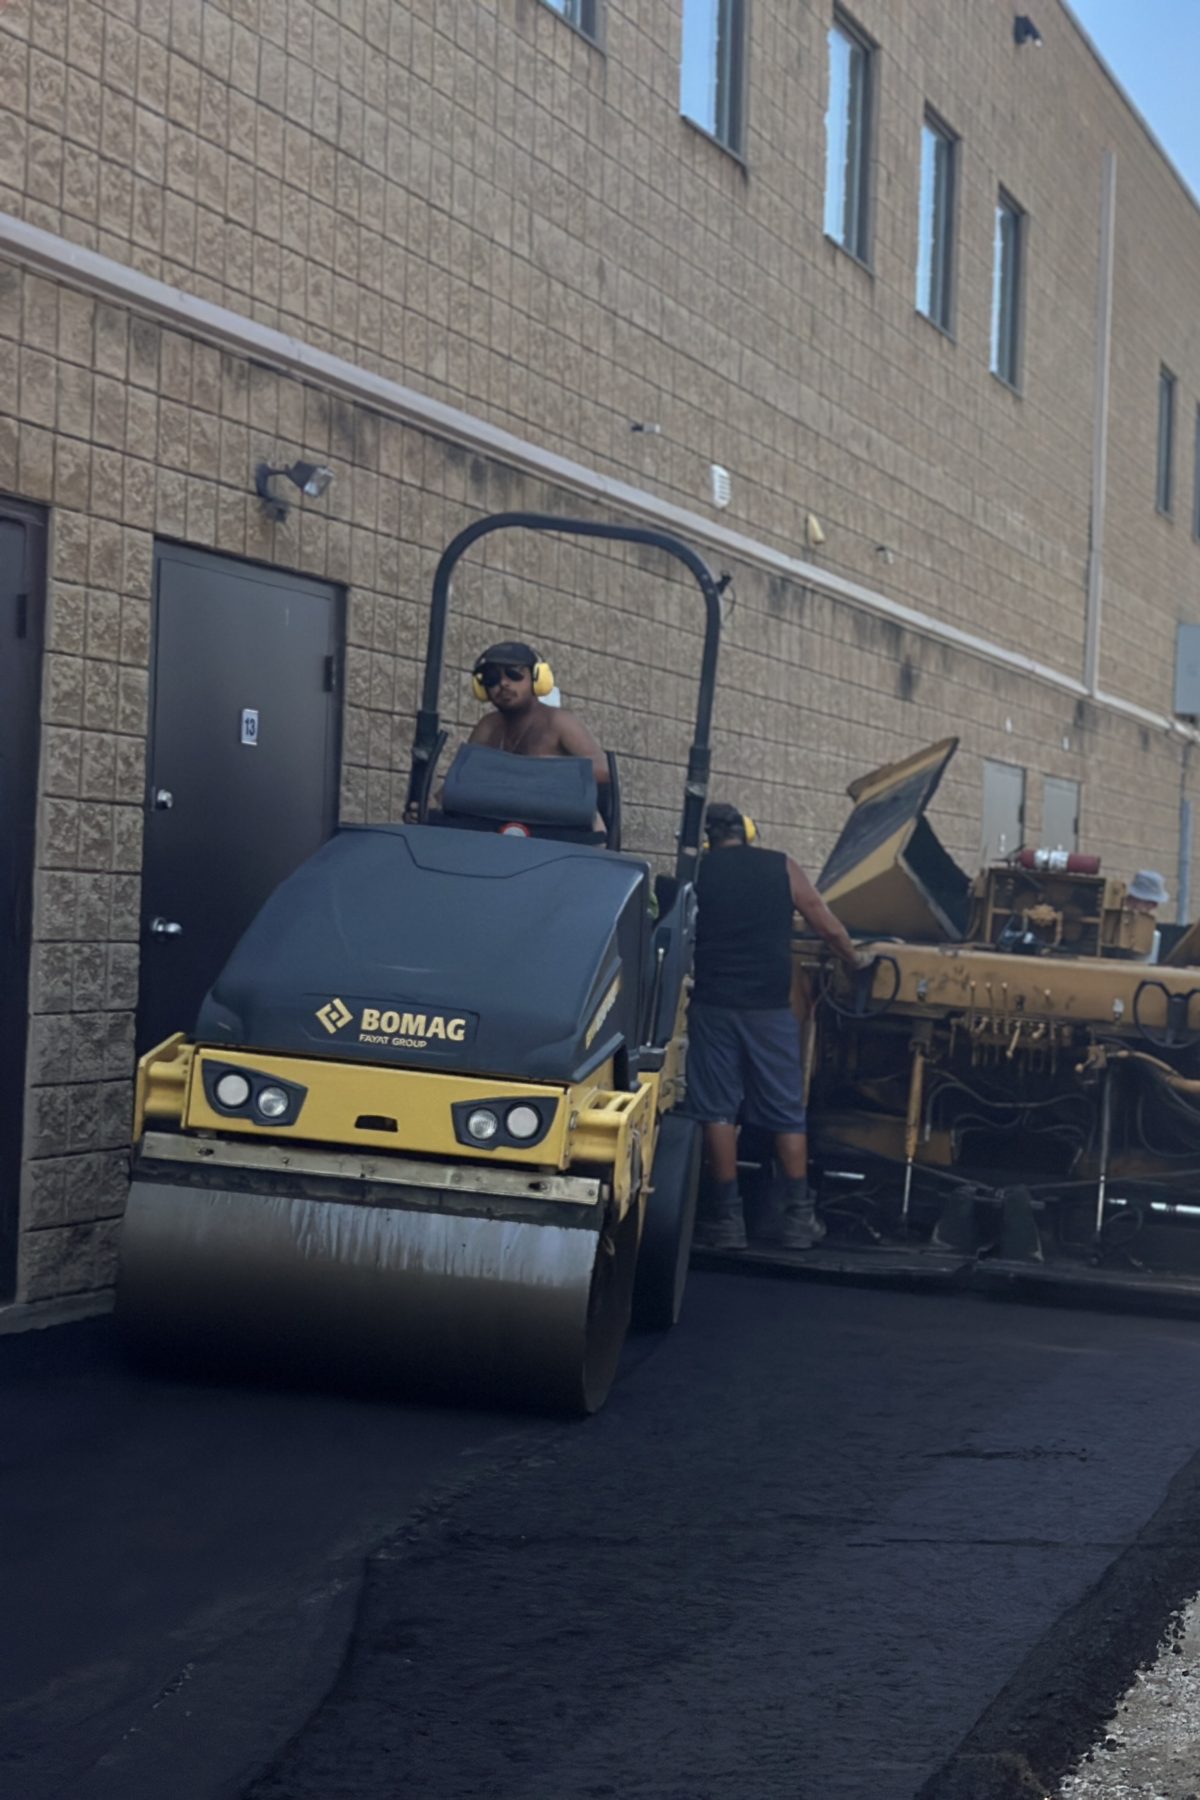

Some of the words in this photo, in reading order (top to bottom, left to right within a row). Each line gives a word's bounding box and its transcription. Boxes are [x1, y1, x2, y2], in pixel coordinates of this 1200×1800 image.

[245, 717, 256, 736] 13
[361, 1008, 466, 1041] BOMAG
[359, 1033, 390, 1044] FAYAT
[392, 1037, 427, 1048] GROUP
